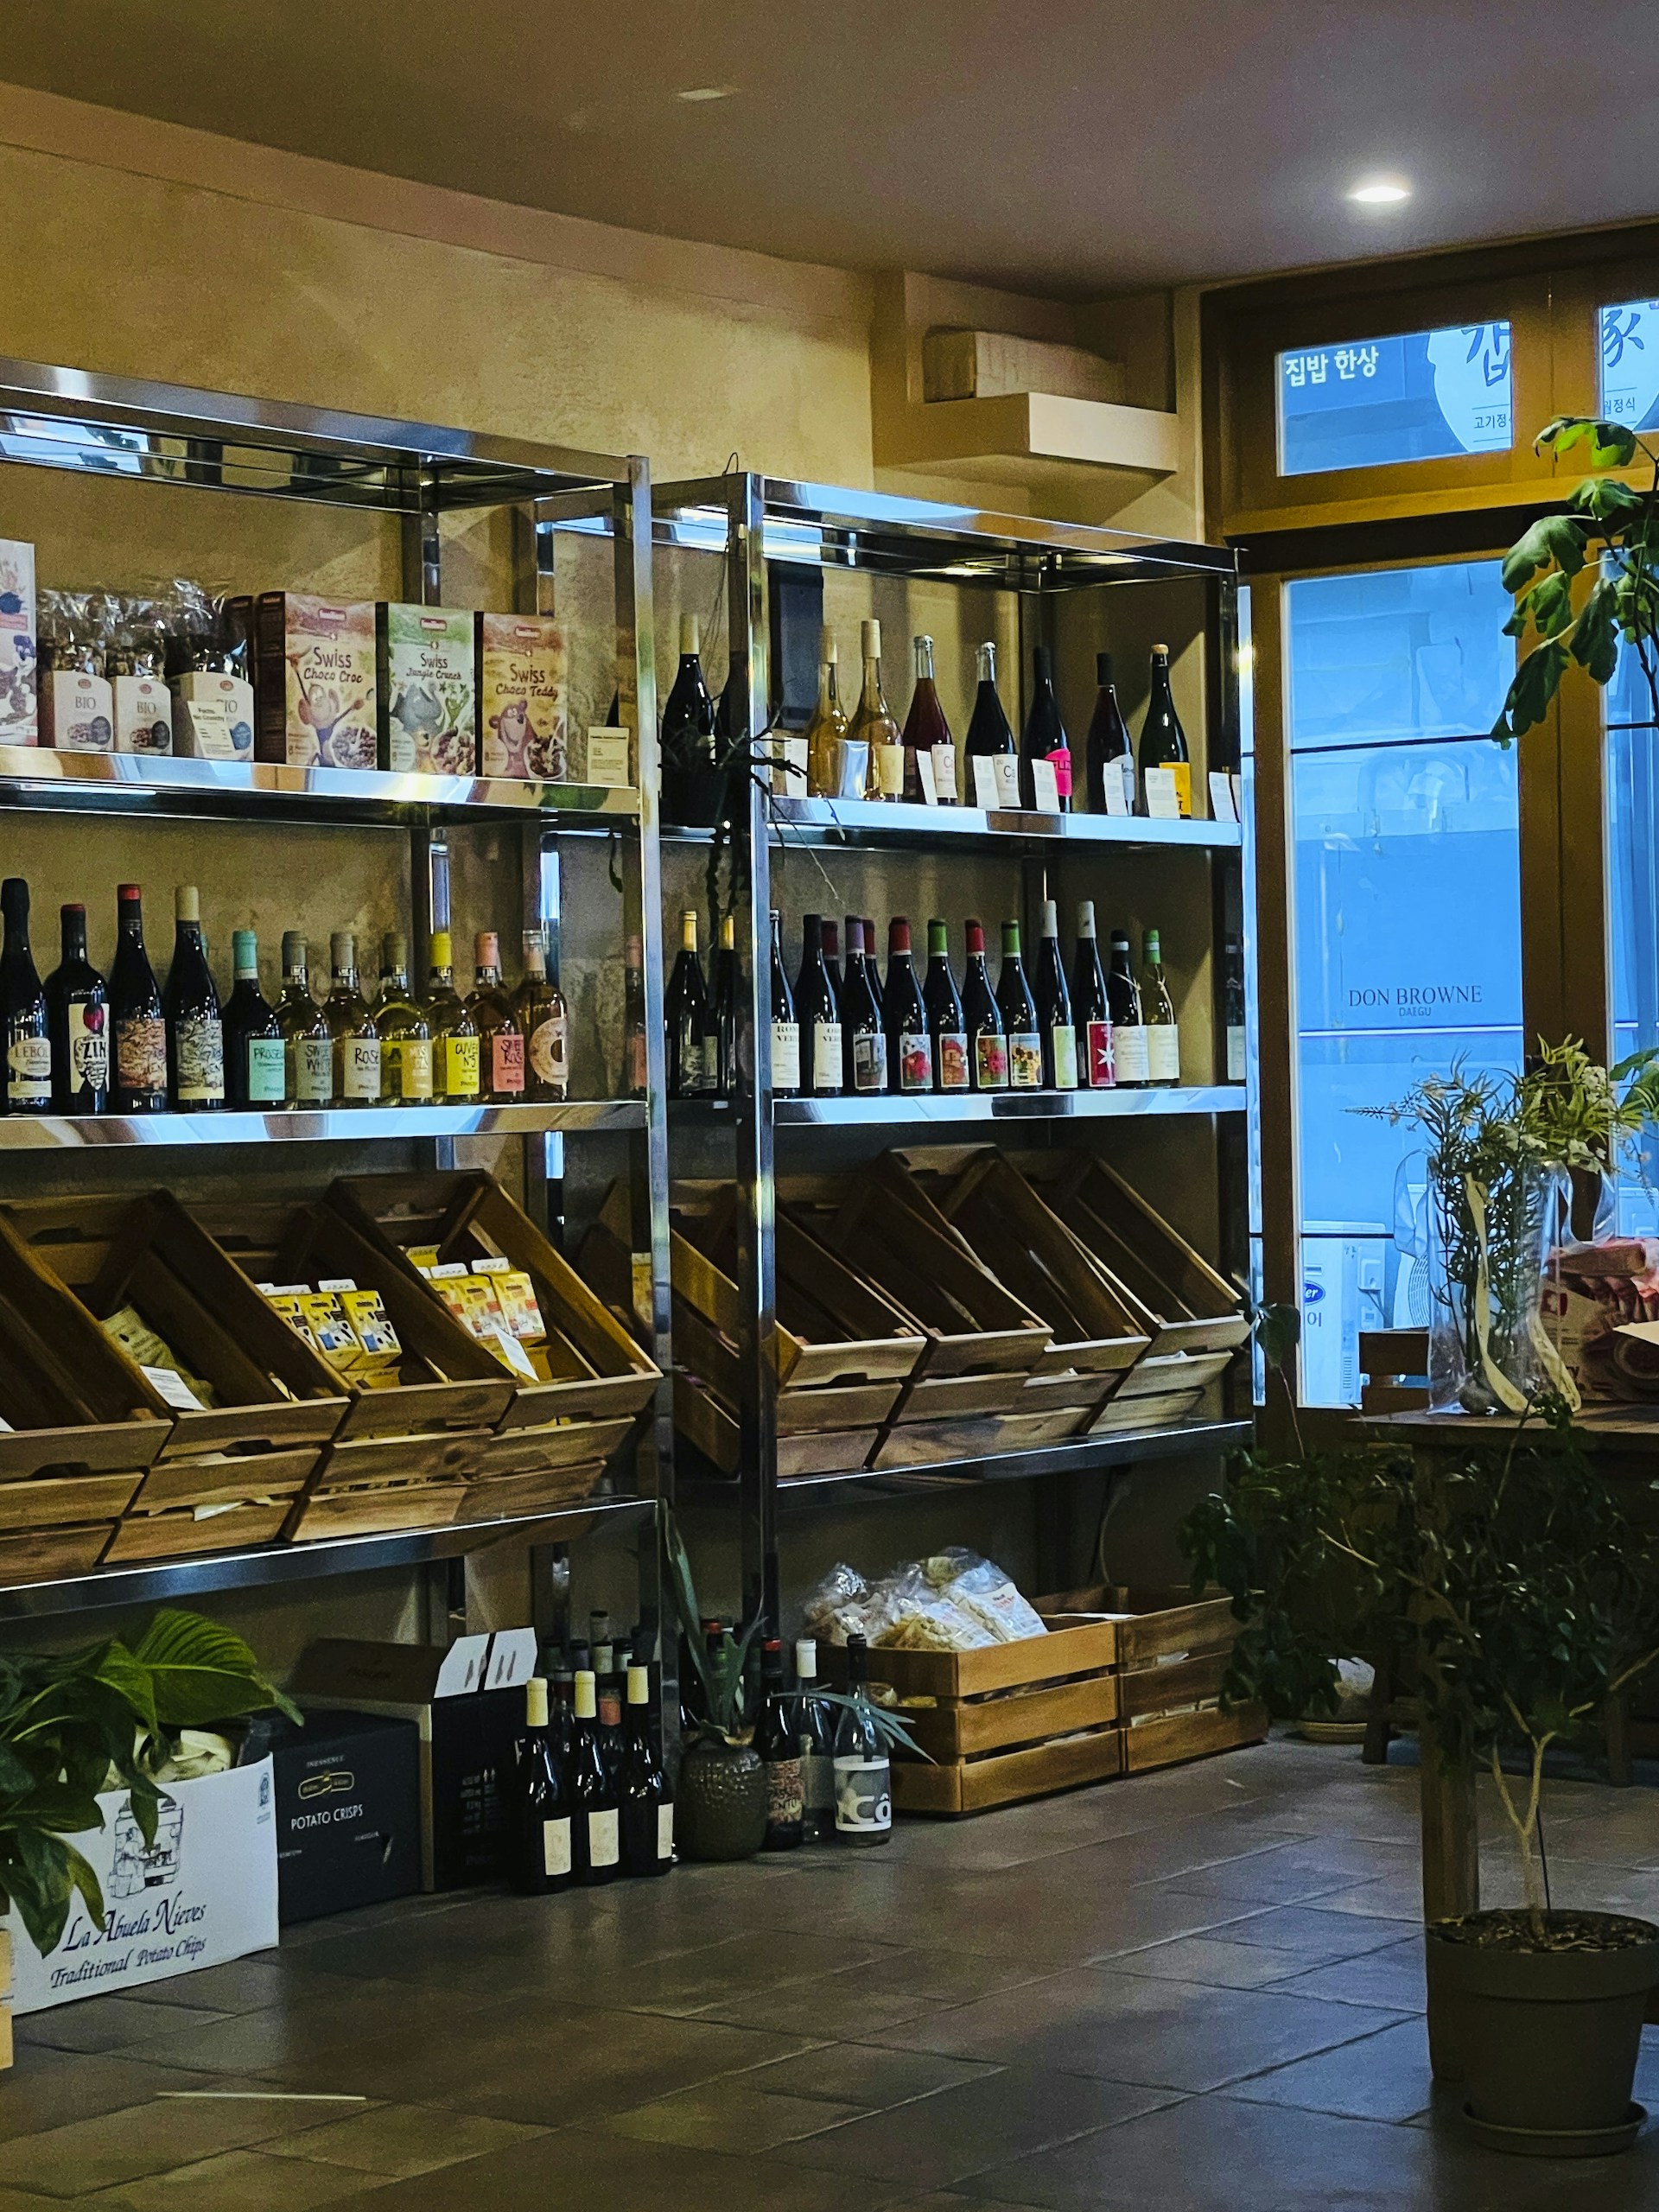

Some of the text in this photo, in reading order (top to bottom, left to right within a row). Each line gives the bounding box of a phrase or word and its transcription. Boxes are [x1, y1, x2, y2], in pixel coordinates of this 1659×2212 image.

[1285, 346, 1379, 387] 집밥 한상
[1473, 413, 1511, 429] 고기정
[313, 646, 352, 669] Swiss
[420, 652, 448, 669] Swiss
[303, 667, 364, 683] Choco Croc
[509, 663, 545, 683] Swiss
[495, 683, 558, 702] Choco Teddy
[75, 696, 97, 710] BIO
[137, 701, 157, 715] BIO
[1349, 985, 1483, 1007] DON BROWNE
[1399, 1006, 1432, 1017] DAEGU
[1304, 1286, 1319, 1299] er
[290, 1803, 364, 1831] POTATO CRISPS
[62, 1890, 208, 1953] La Abuela Nieves
[50, 1935, 208, 1989] Traditional Potato Chips
